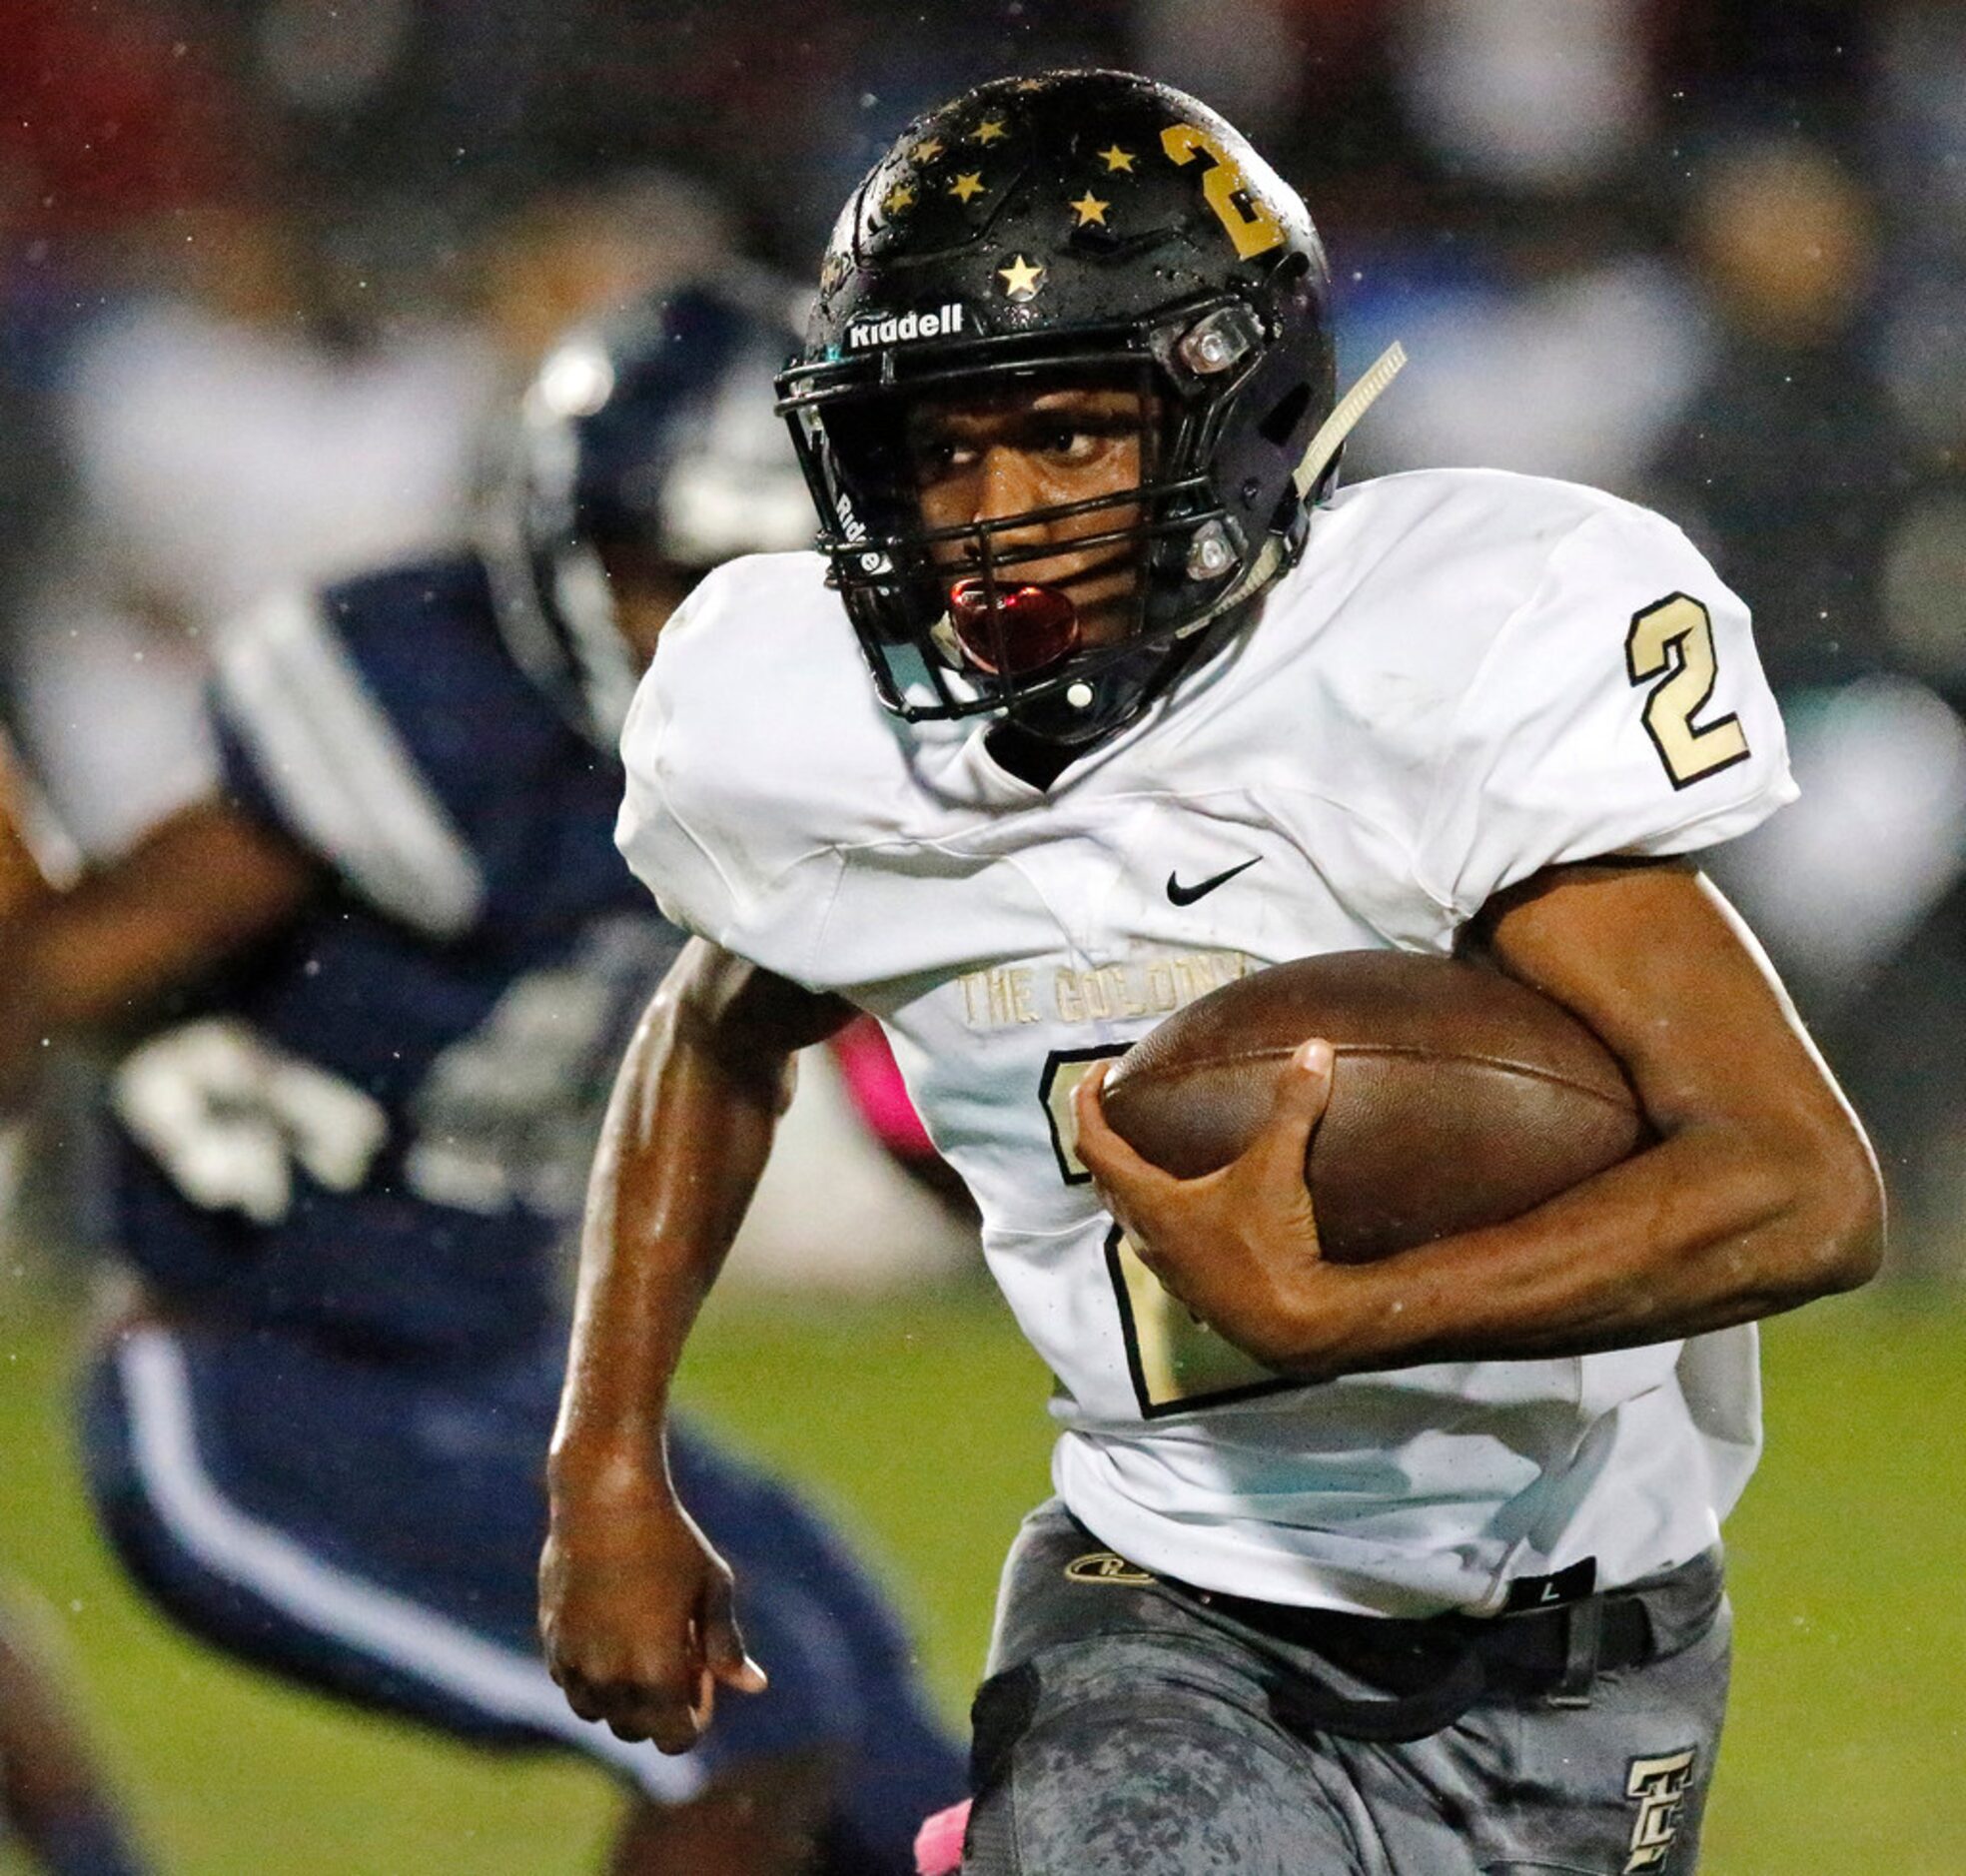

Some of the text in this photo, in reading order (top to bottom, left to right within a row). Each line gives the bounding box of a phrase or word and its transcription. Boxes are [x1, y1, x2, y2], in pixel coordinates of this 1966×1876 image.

[1160, 122, 1286, 262] 2
[850, 303, 963, 349] Riddell
[1624, 590, 1752, 792] 2
[957, 967, 1039, 1025] THE
[1540, 1581, 1560, 1603] L
